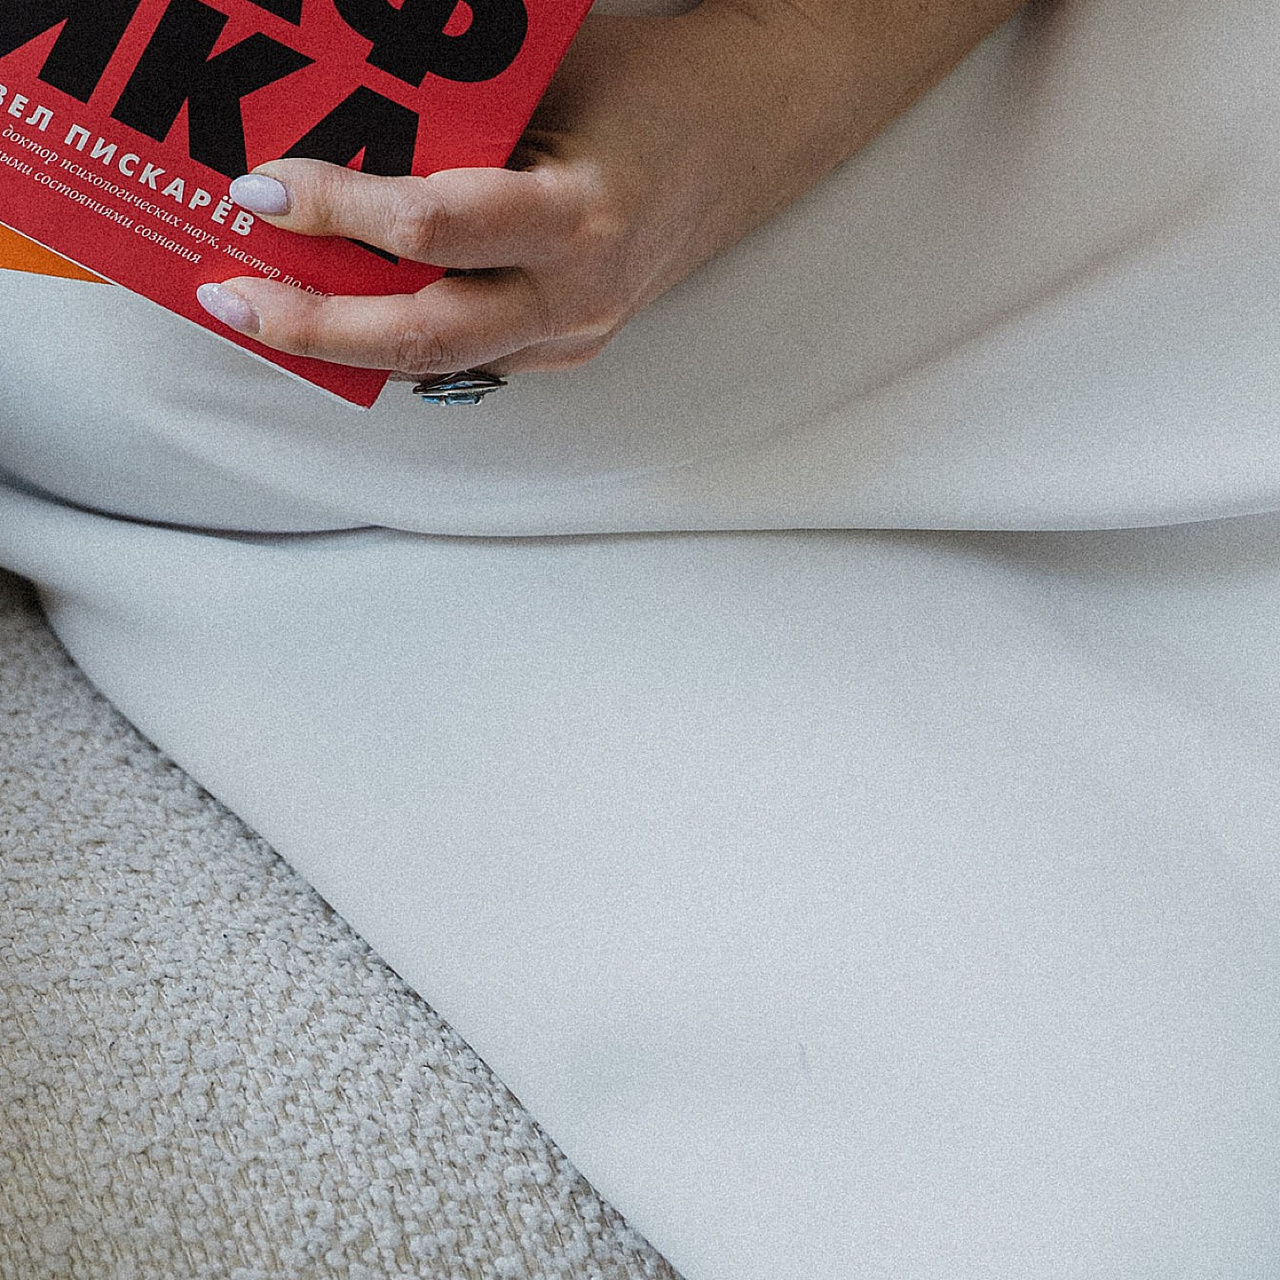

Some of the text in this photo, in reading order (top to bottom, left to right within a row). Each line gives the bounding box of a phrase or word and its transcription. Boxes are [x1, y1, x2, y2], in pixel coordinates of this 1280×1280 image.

[2, 124, 59, 165] доктор
[60, 158, 182, 228] психологических
[183, 220, 220, 250] наук,
[223, 244, 281, 280] мастер
[34, 171, 134, 230] состояниями
[134, 223, 202, 265] сознания
[64, 123, 256, 237] ПИСКАРЁВ
